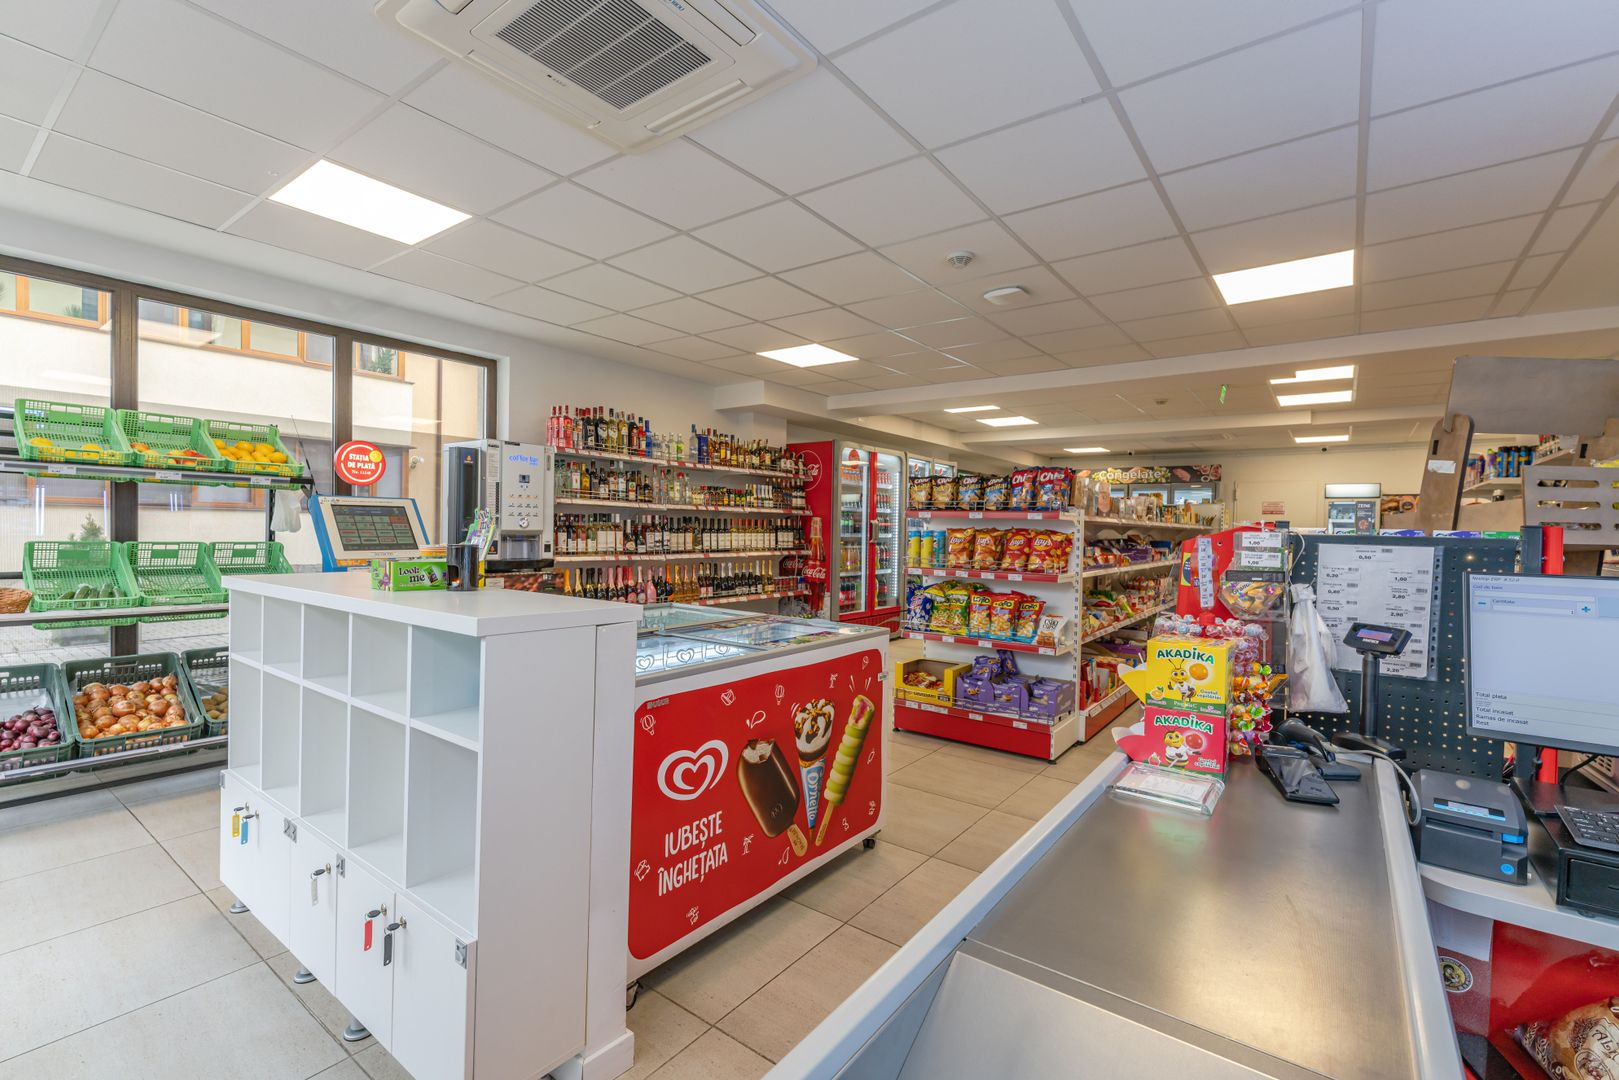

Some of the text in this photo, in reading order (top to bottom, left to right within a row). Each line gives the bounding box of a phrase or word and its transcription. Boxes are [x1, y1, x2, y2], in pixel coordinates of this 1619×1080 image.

[1099, 470, 1162, 480] Congelate
[399, 567, 420, 577] Look
[410, 574, 425, 582] me
[664, 810, 723, 857] IUBEȘTE
[658, 842, 728, 896] ÎNGHEȚATA
